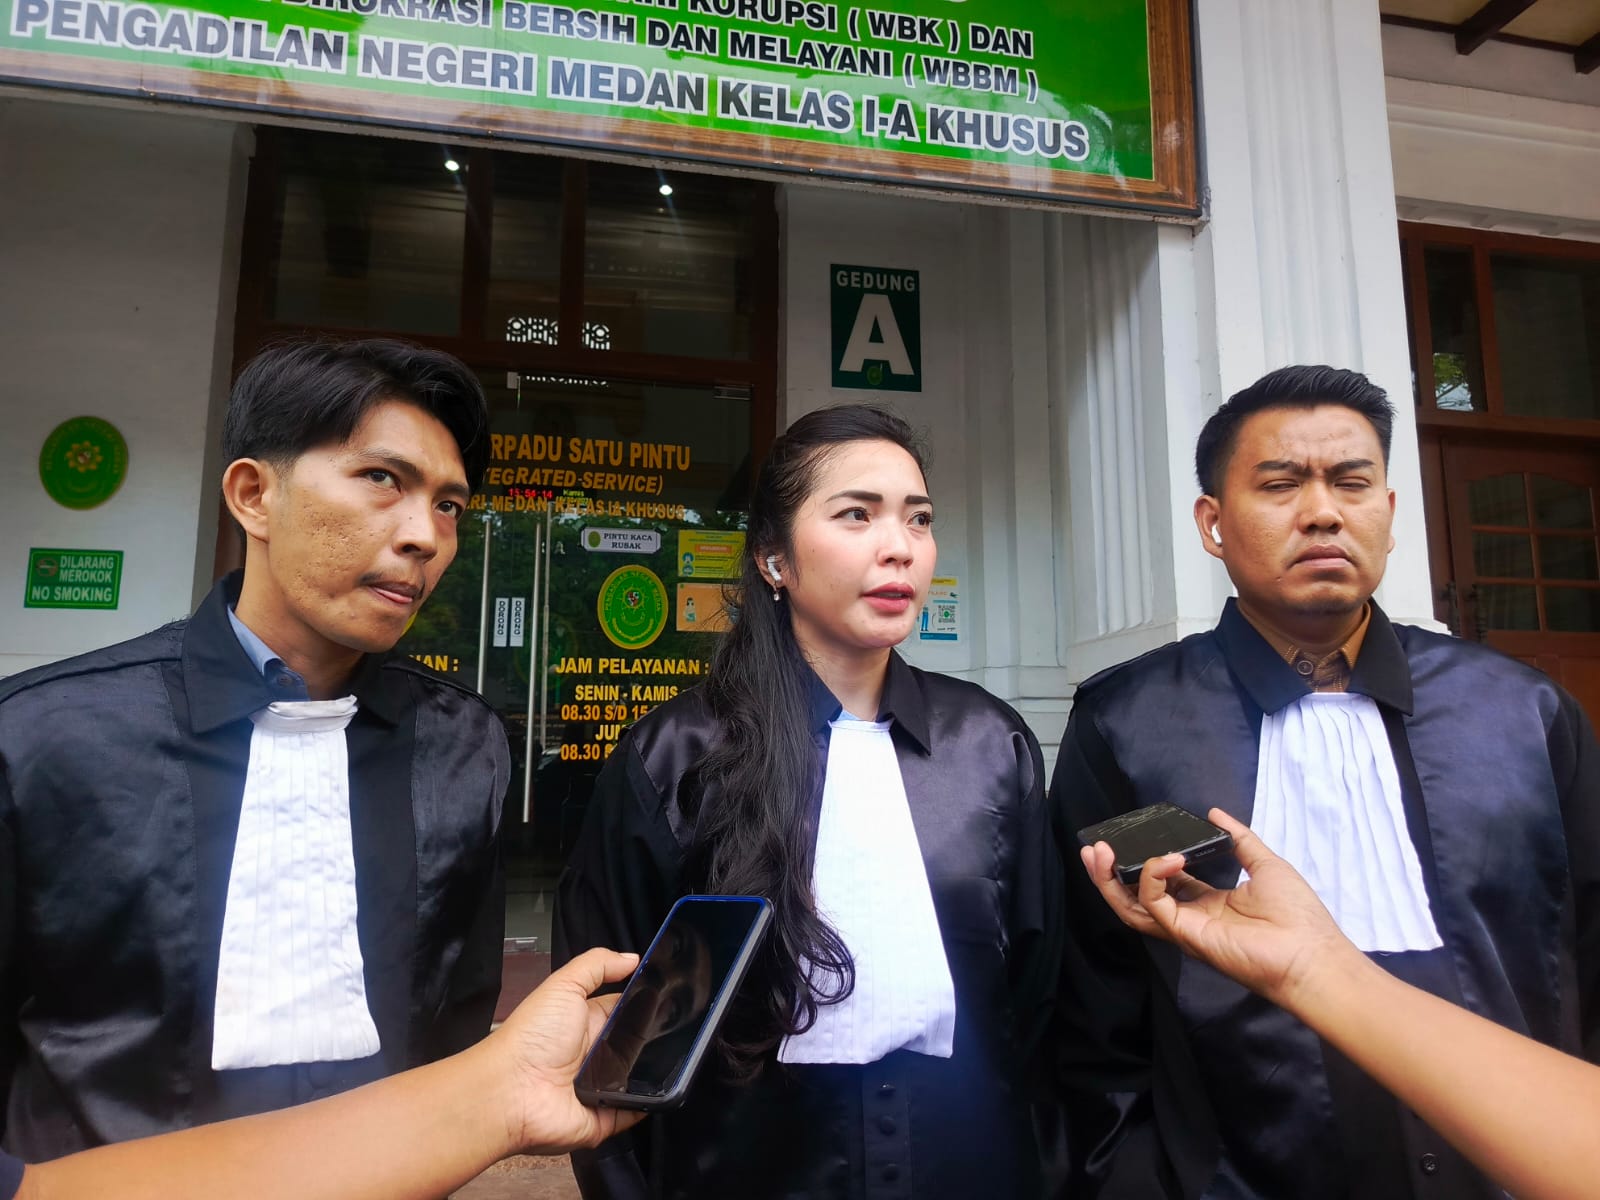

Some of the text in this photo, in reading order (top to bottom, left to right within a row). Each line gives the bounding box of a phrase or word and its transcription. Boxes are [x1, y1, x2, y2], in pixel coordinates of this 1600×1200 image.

[869, 11, 943, 45] WBK
[970, 22, 1033, 58] DAN
[504, 1, 636, 44] BERSIH
[648, 18, 718, 55] DAN
[729, 29, 892, 78] MELAYANI
[923, 56, 1018, 95] WBBM
[11, 1, 1090, 160] PENGADILAN NEGERI MEDAN KELAS I-A KHUSUS
[836, 270, 916, 292] GEDUNG
[839, 293, 915, 375] A
[490, 433, 690, 471] RPADU SATU PINTU
[491, 494, 547, 513] MEDAN
[555, 496, 601, 515] KELAS
[625, 501, 685, 520] KHUSUS
[604, 532, 653, 542] PINTU KACA
[611, 541, 642, 550] RUSAK
[60, 555, 114, 569] DILARANG
[59, 569, 113, 583] MEROKOK
[31, 585, 113, 602] NO SMOKING
[556, 657, 592, 674] JAM
[598, 658, 700, 675] PELAYANAN
[574, 684, 619, 701] SENIN
[631, 684, 679, 702] KAMIS
[561, 704, 600, 721] 08.30
[604, 704, 628, 721] S/D
[561, 743, 600, 760] 08.30
